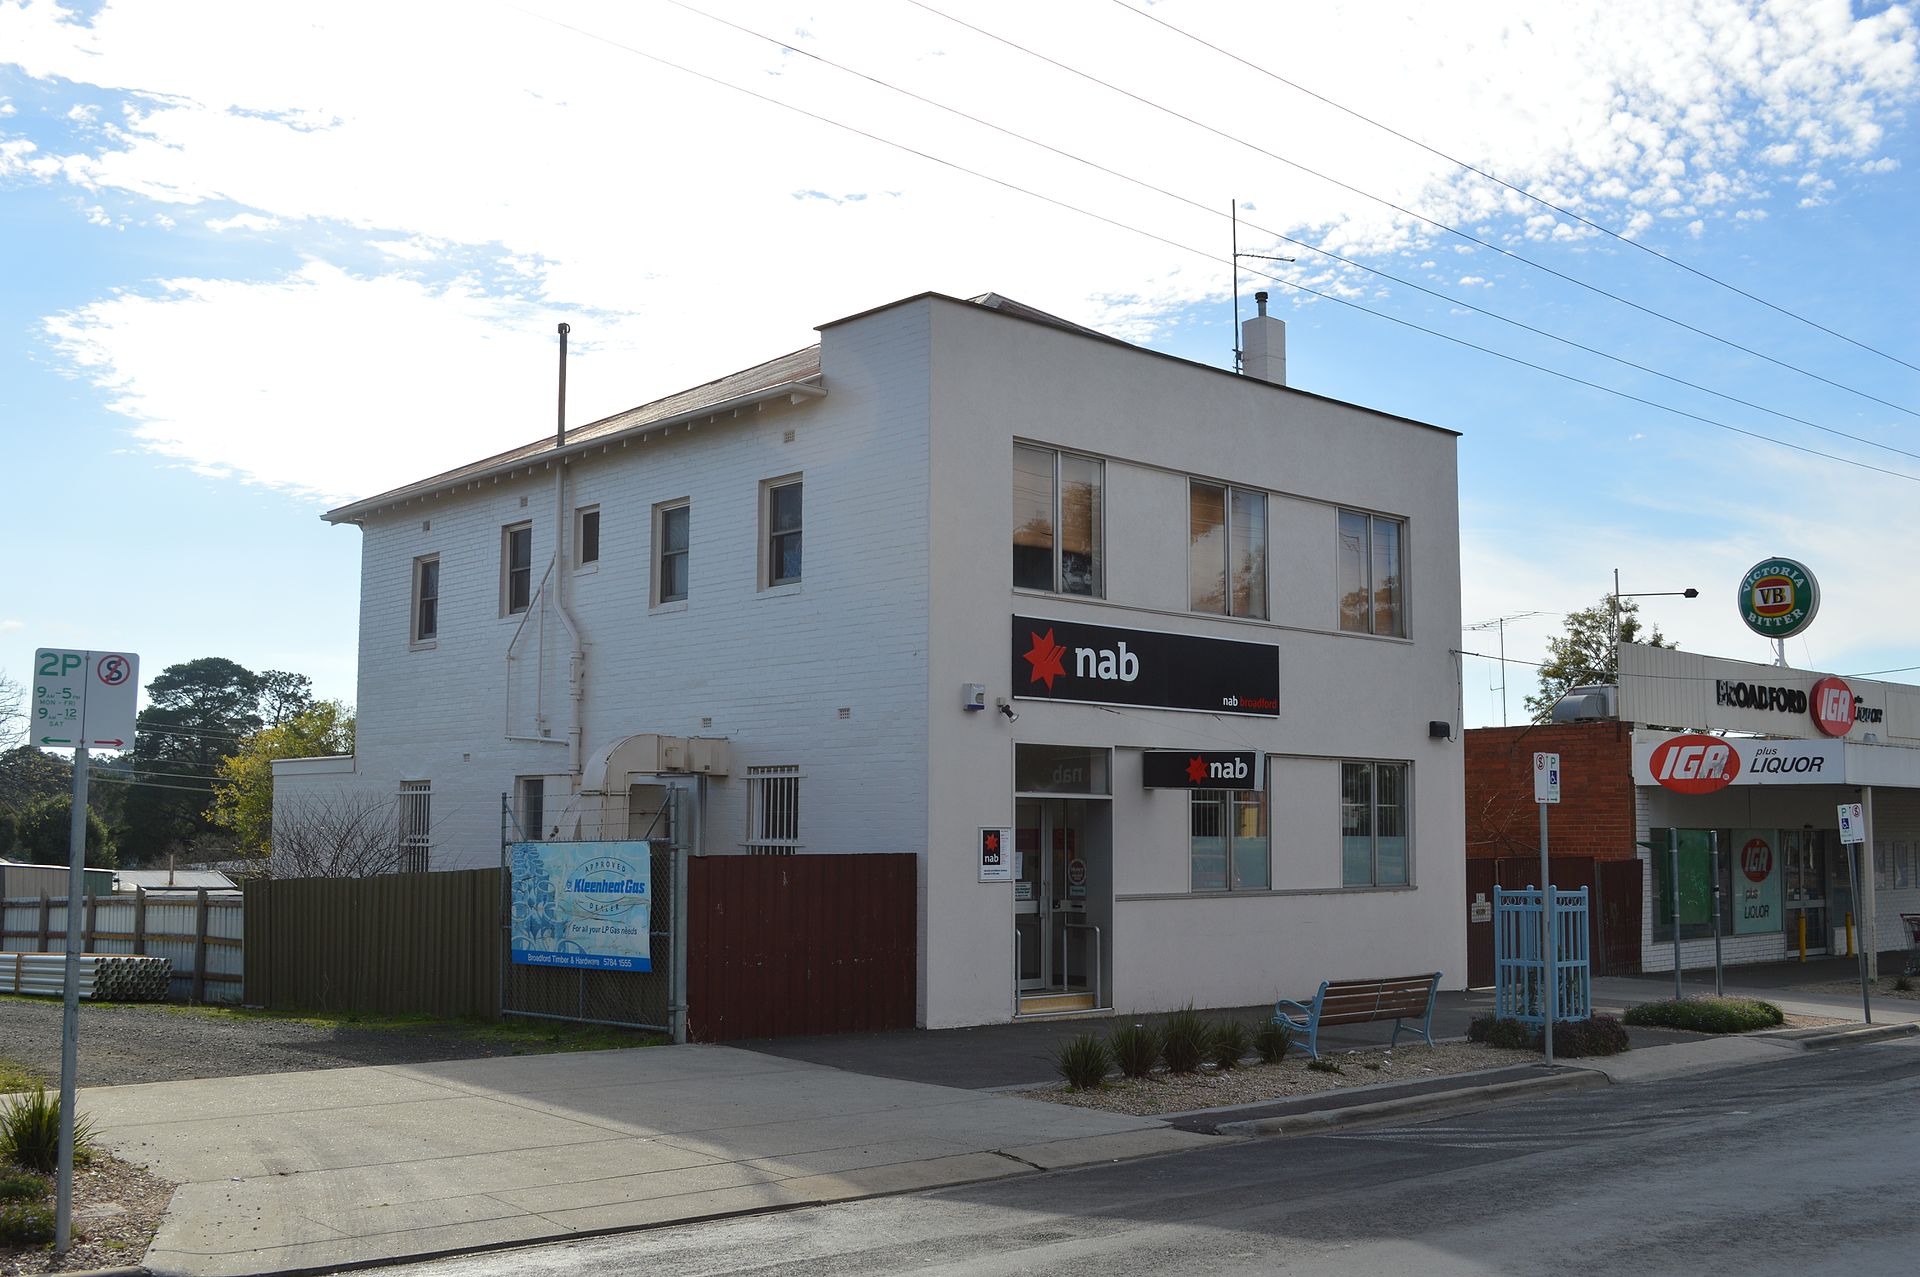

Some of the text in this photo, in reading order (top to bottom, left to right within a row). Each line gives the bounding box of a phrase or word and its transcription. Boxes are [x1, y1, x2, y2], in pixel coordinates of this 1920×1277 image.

[1743, 566, 1804, 593] VICTORIA
[1758, 587, 1787, 605] VB
[1746, 608, 1804, 627] BITTER
[39, 652, 82, 677] 2P
[1075, 641, 1140, 682] nab
[1222, 694, 1277, 711] nab broadford
[1820, 688, 1850, 723] IGA
[1756, 747, 1777, 757] plus
[1209, 757, 1248, 780] nab
[1551, 757, 1556, 768] P
[1659, 744, 1730, 781] IGA
[1750, 756, 1824, 774] LIQUOR
[585, 861, 626, 873] APPROVED
[984, 853, 999, 863] nab
[1745, 847, 1769, 872] IGA
[574, 878, 645, 894] Kleenheat Gas
[1744, 904, 1769, 919] LIQUOR
[572, 924, 581, 932] For
[588, 926, 600, 935] your
[601, 925, 609, 934] LP
[609, 926, 620, 934] Gas
[620, 926, 637, 935] needs
[527, 953, 551, 963] Broadford
[552, 954, 569, 964] Timber
[575, 956, 600, 966] Hardware
[603, 958, 617, 967] 5784
